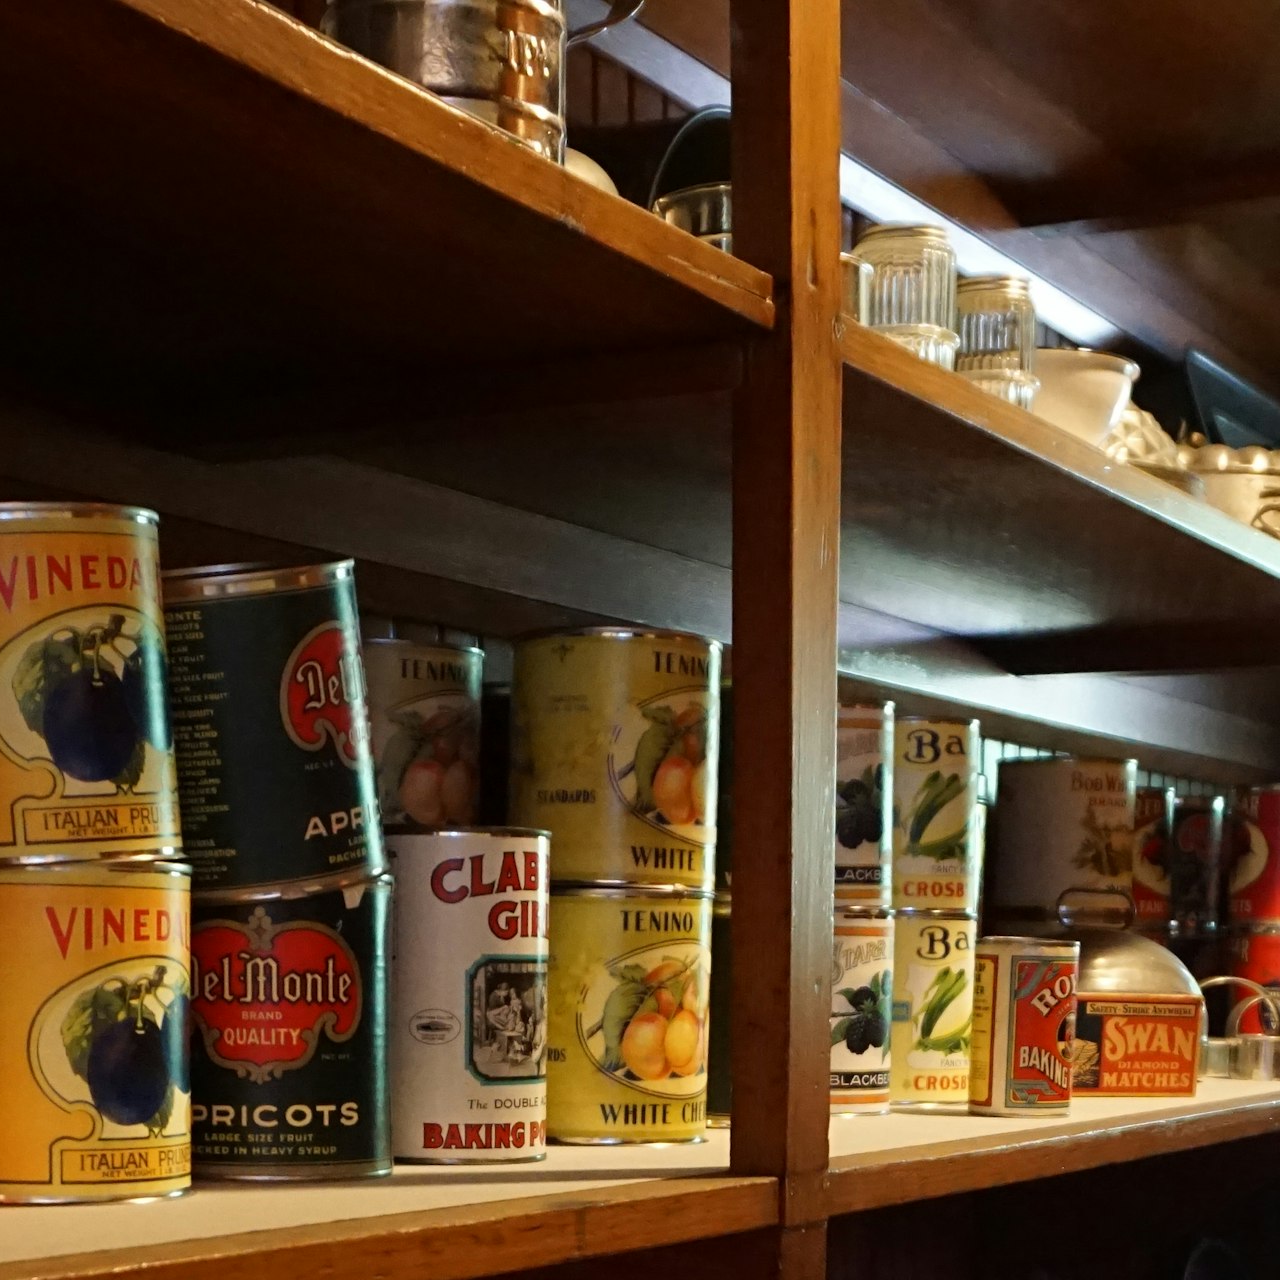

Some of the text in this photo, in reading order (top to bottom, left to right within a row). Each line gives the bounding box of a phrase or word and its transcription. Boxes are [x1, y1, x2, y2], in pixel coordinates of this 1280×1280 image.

[43, 809, 119, 831] ITALIAN
[631, 845, 696, 872] WHITE
[620, 910, 693, 933] TENINO
[46, 905, 189, 961] VINED
[238, 952, 352, 1004] Monte
[241, 1011, 283, 1021] BRAND
[1152, 1005, 1192, 1015] ANYWHERE
[223, 1027, 302, 1046] QUALITY
[1104, 1015, 1196, 1062] SWAN
[1019, 1045, 1068, 1090] BAKING
[1118, 1061, 1180, 1070] DIAMOND
[1103, 1071, 1190, 1088] MATCHES
[467, 1097, 539, 1110] The DOUBLE
[600, 1104, 672, 1125] WHITE
[247, 1133, 274, 1143] SIZE
[279, 1132, 315, 1143] FRUIT
[423, 1121, 525, 1149] BAKING
[233, 1146, 248, 1156] IN
[251, 1146, 294, 1156] HEAVY
[297, 1145, 338, 1156] SYRUP
[80, 1151, 149, 1171] ITALIAN
